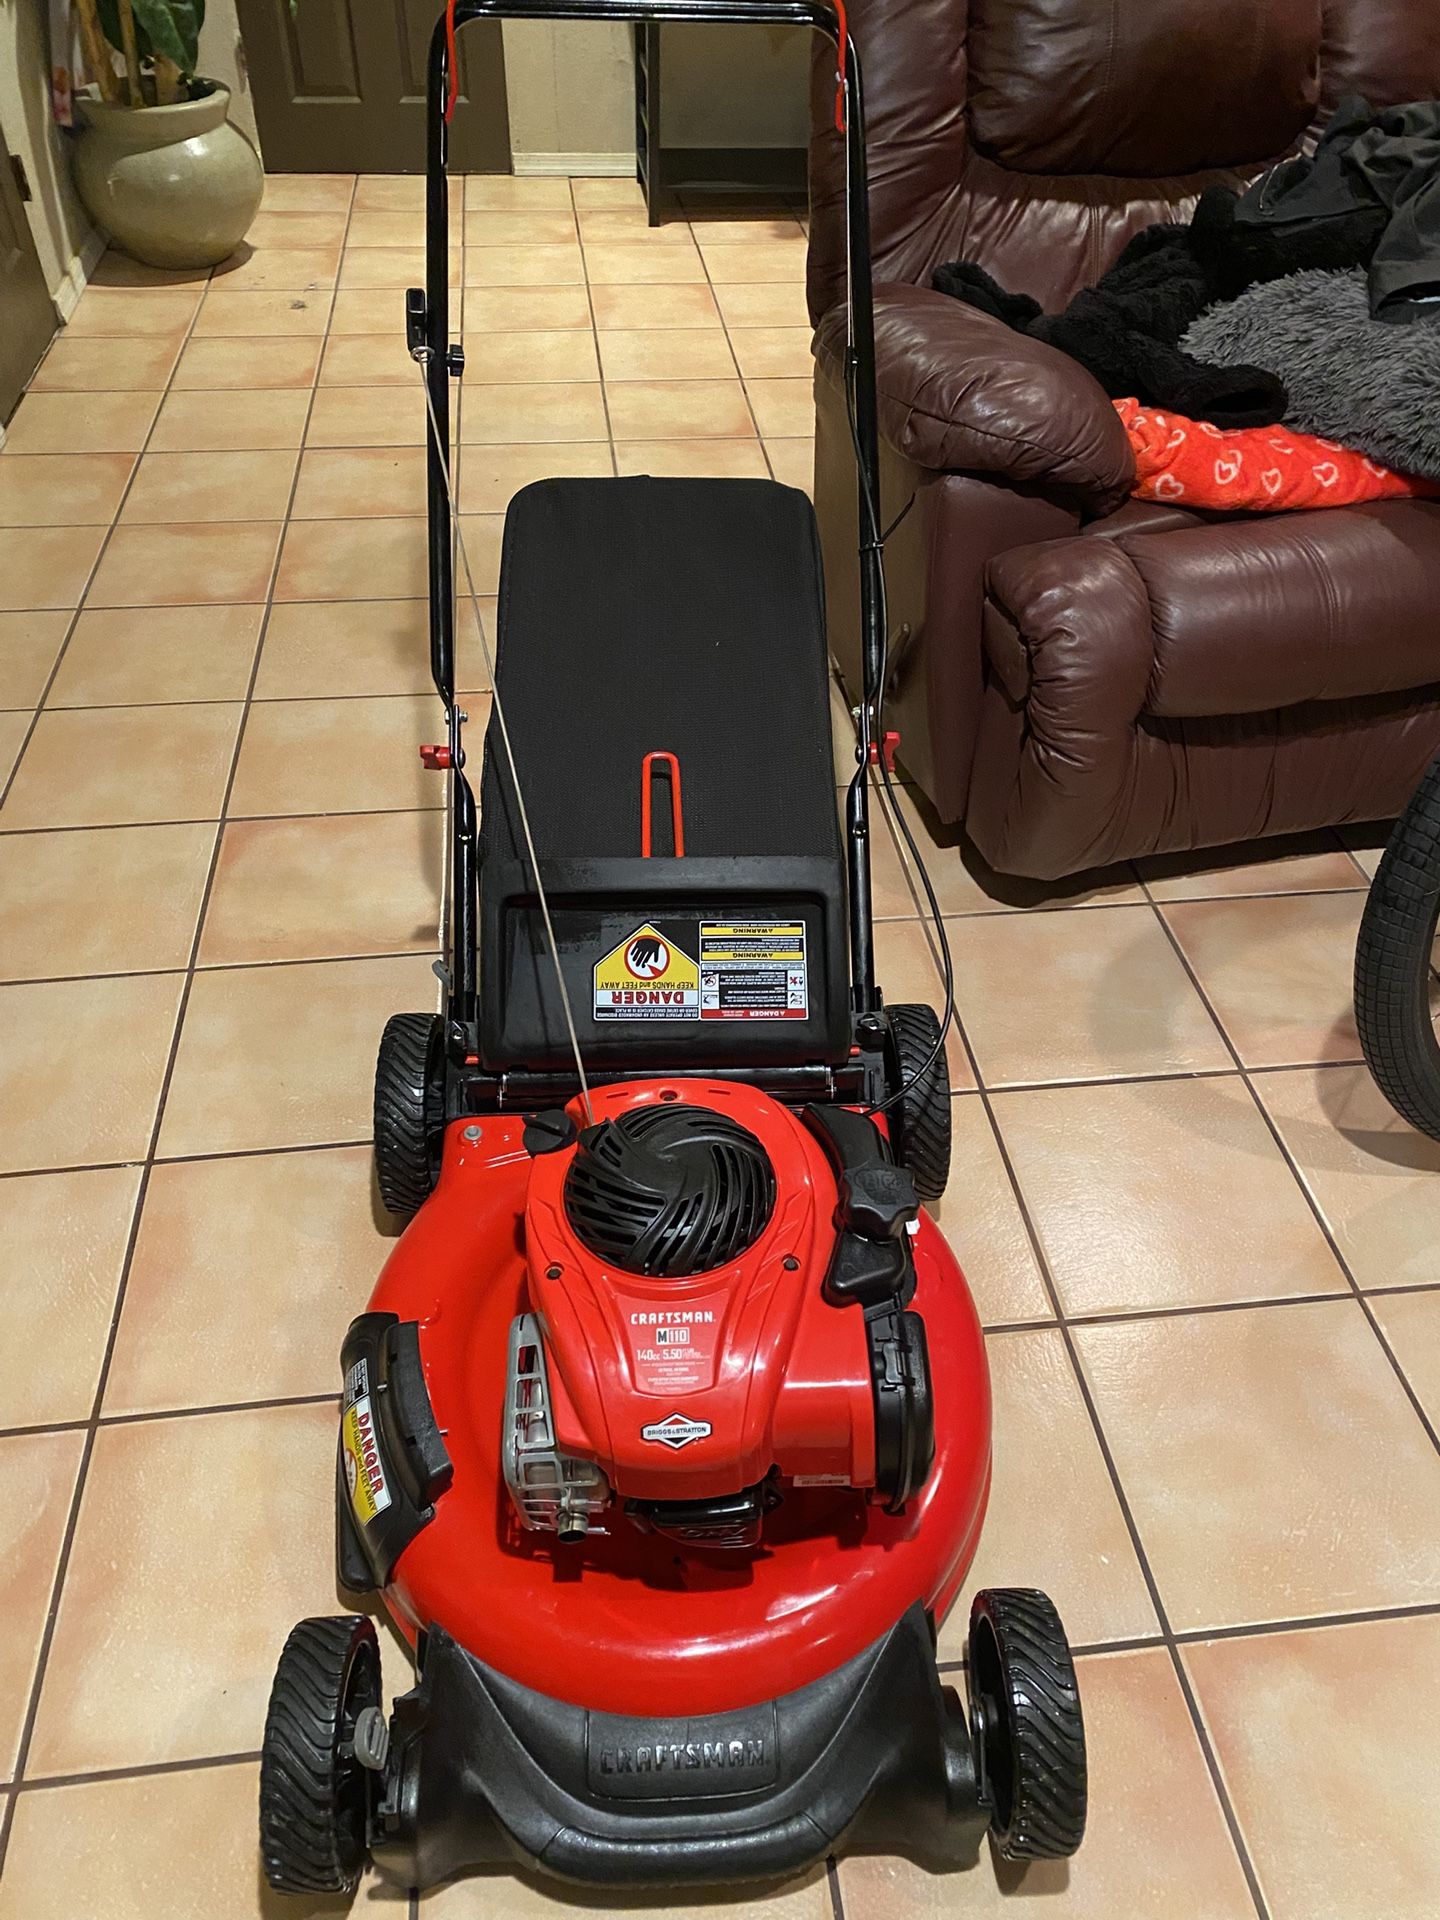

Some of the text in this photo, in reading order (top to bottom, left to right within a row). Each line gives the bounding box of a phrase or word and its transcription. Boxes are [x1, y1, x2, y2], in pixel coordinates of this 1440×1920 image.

[600, 981, 694, 989] KEEP HANDS and FEET AWAY
[611, 991, 684, 1004] DANGER
[630, 1311, 714, 1325] CRAFTSMAN
[636, 1348, 661, 1361] 140cc
[662, 1348, 682, 1360] 5.50
[358, 1412, 384, 1495] DANGER
[359, 1467, 370, 1488] FEET
[365, 1488, 377, 1512] AWAY
[600, 1739, 765, 1774] CRAFTSMAN
